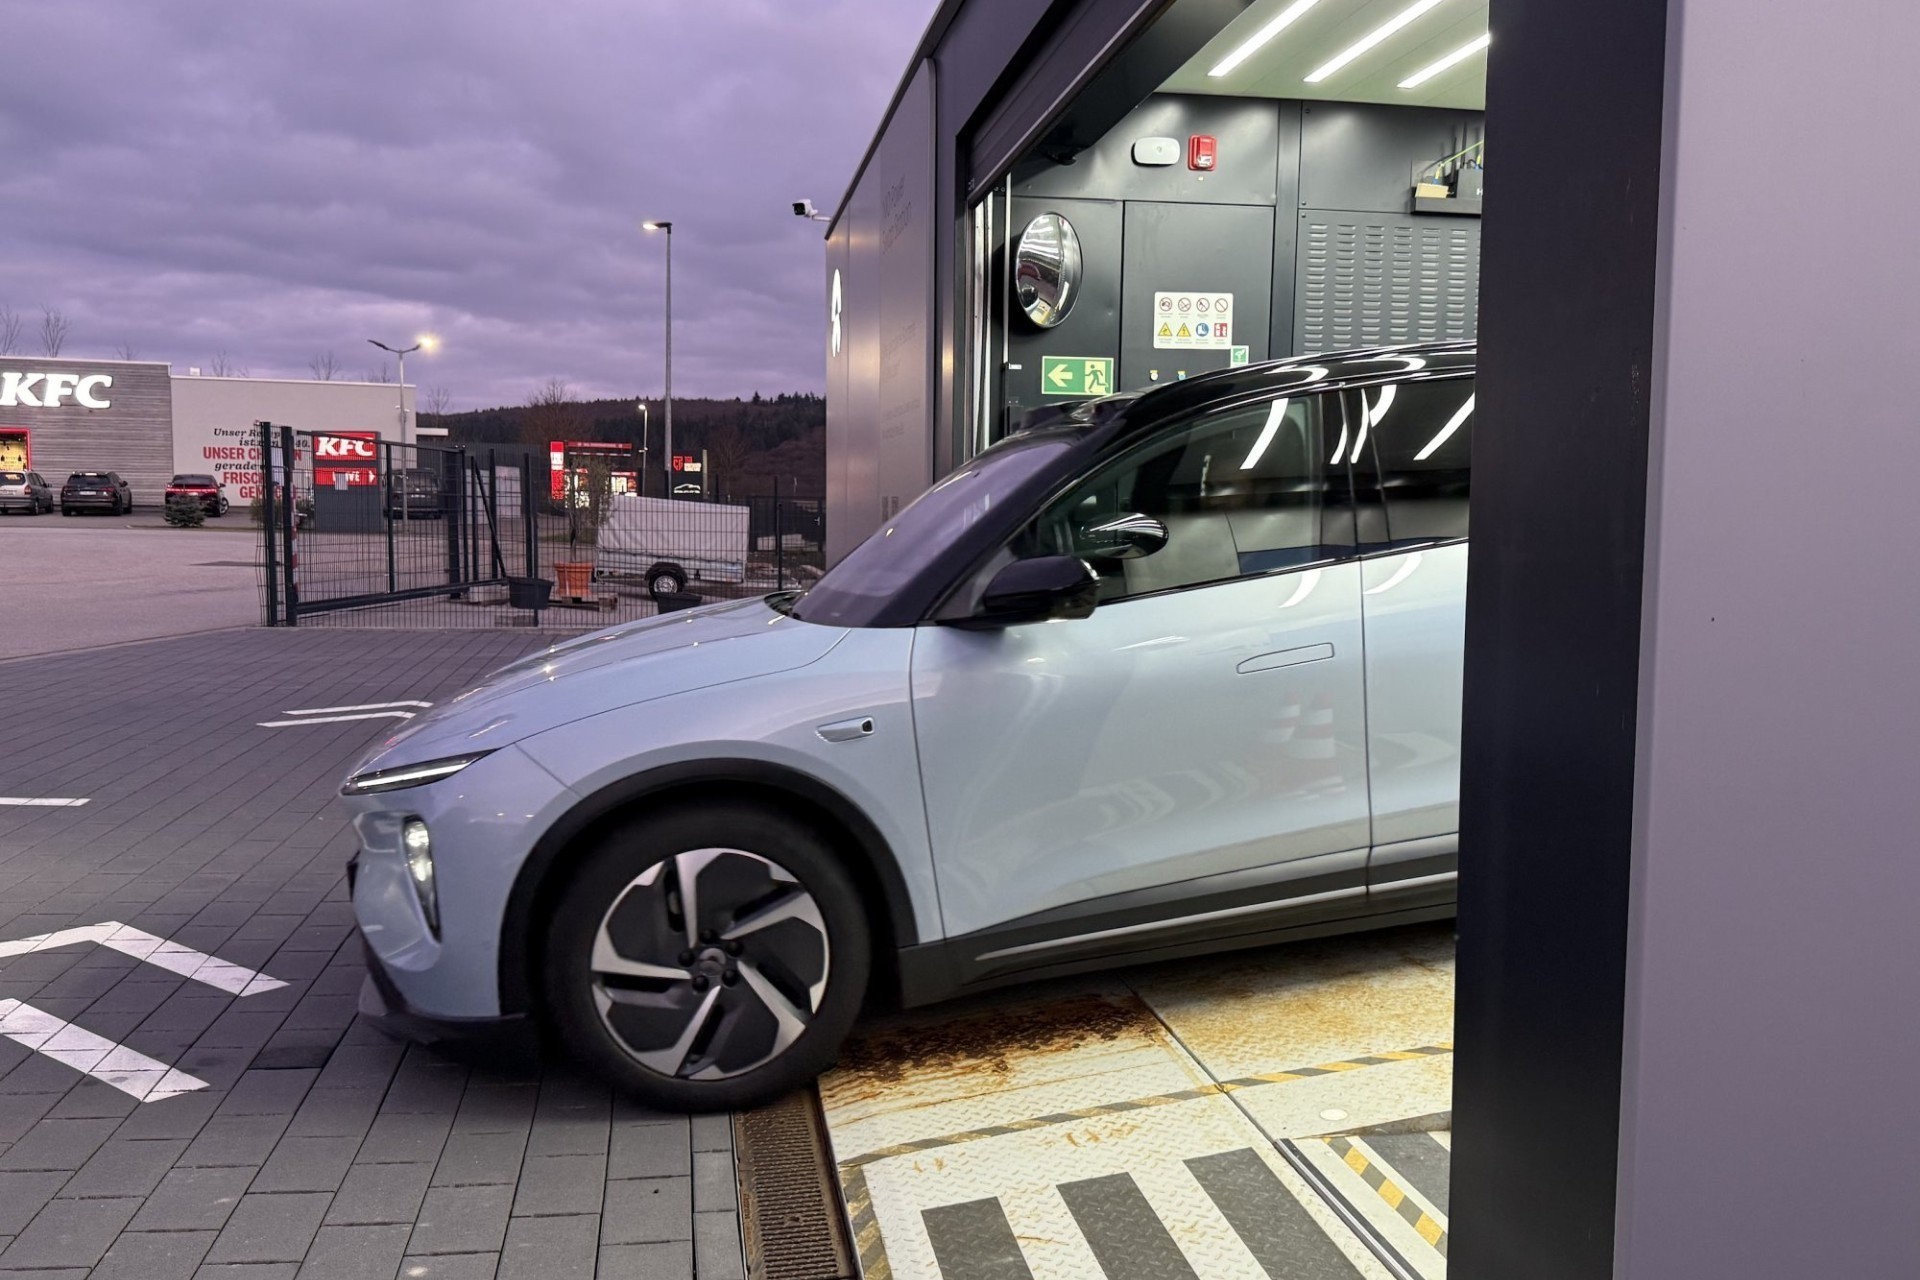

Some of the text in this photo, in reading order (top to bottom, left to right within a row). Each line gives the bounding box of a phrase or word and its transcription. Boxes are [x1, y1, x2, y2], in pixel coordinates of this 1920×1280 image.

[0, 372, 113, 409] KFC
[214, 428, 247, 437] Unser
[239, 437, 255, 447] ist
[315, 436, 374, 457] KFC
[203, 446, 245, 460] UNSER
[214, 461, 257, 472] gerade
